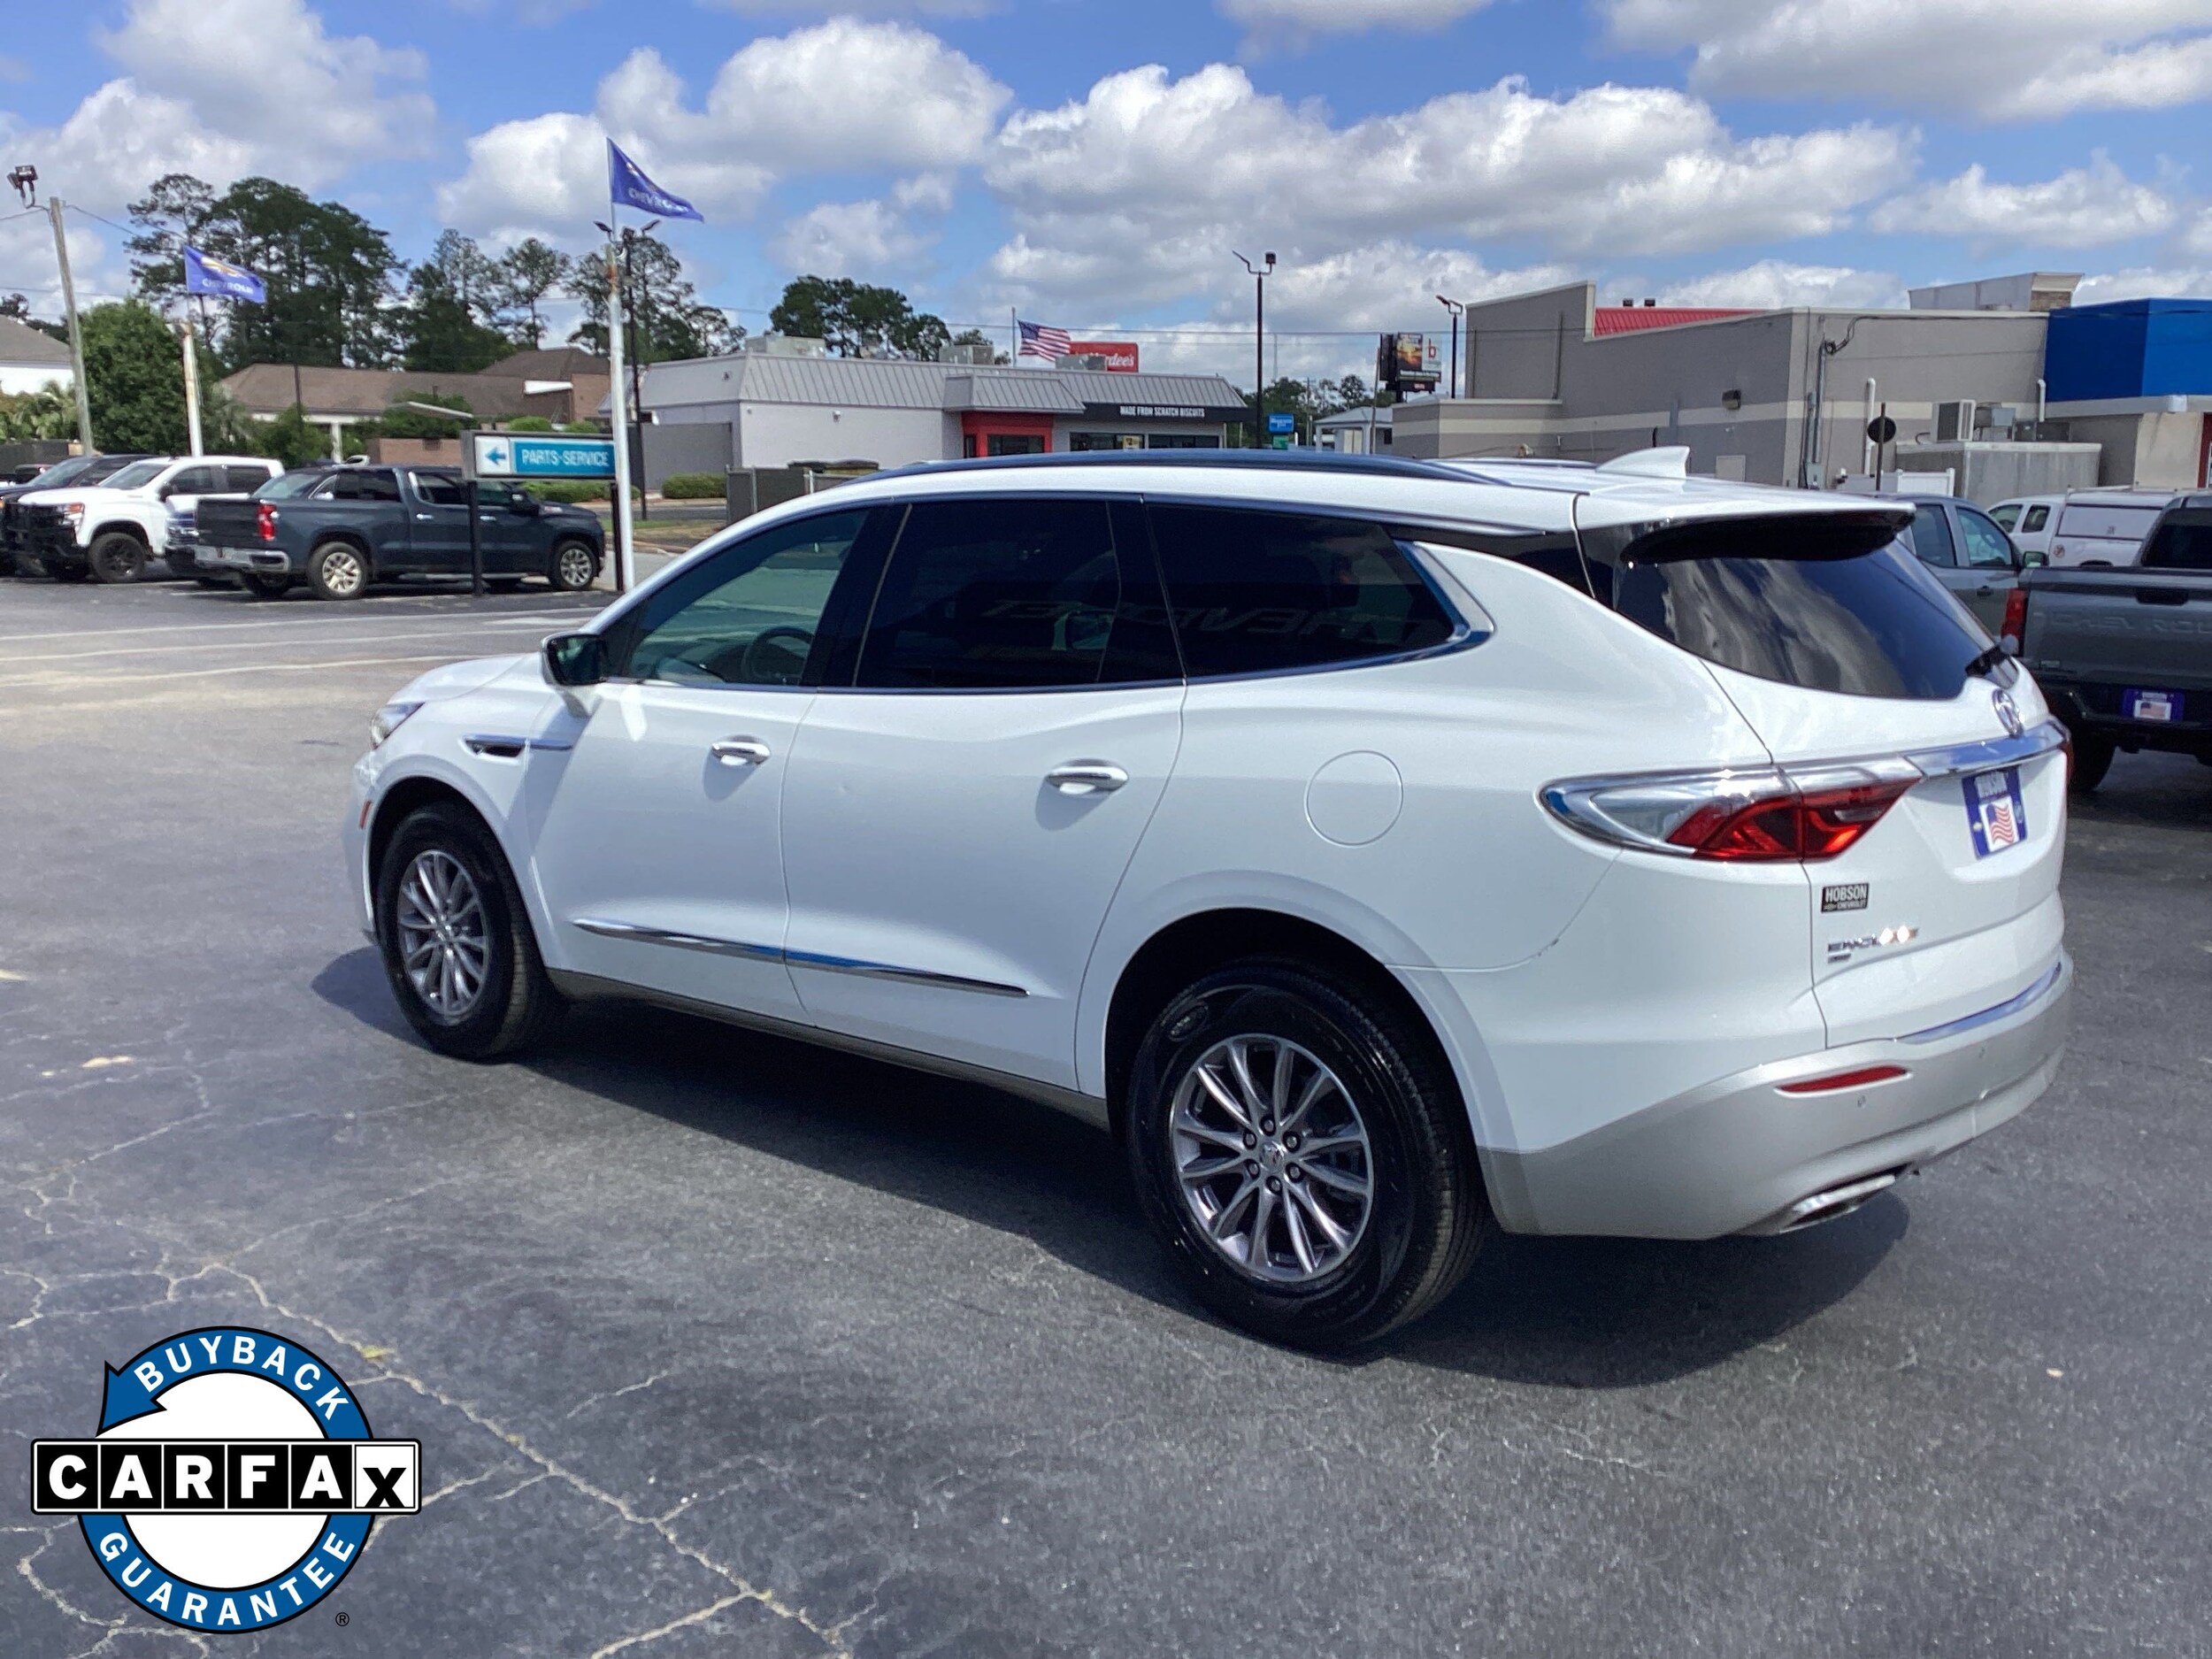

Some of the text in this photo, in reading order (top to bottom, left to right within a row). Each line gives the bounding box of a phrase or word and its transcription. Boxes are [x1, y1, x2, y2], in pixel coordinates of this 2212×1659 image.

[1119, 405, 1205, 418] MADE FROM SCRATCH BISCUITS
[1825, 885, 1867, 902] HOBSON
